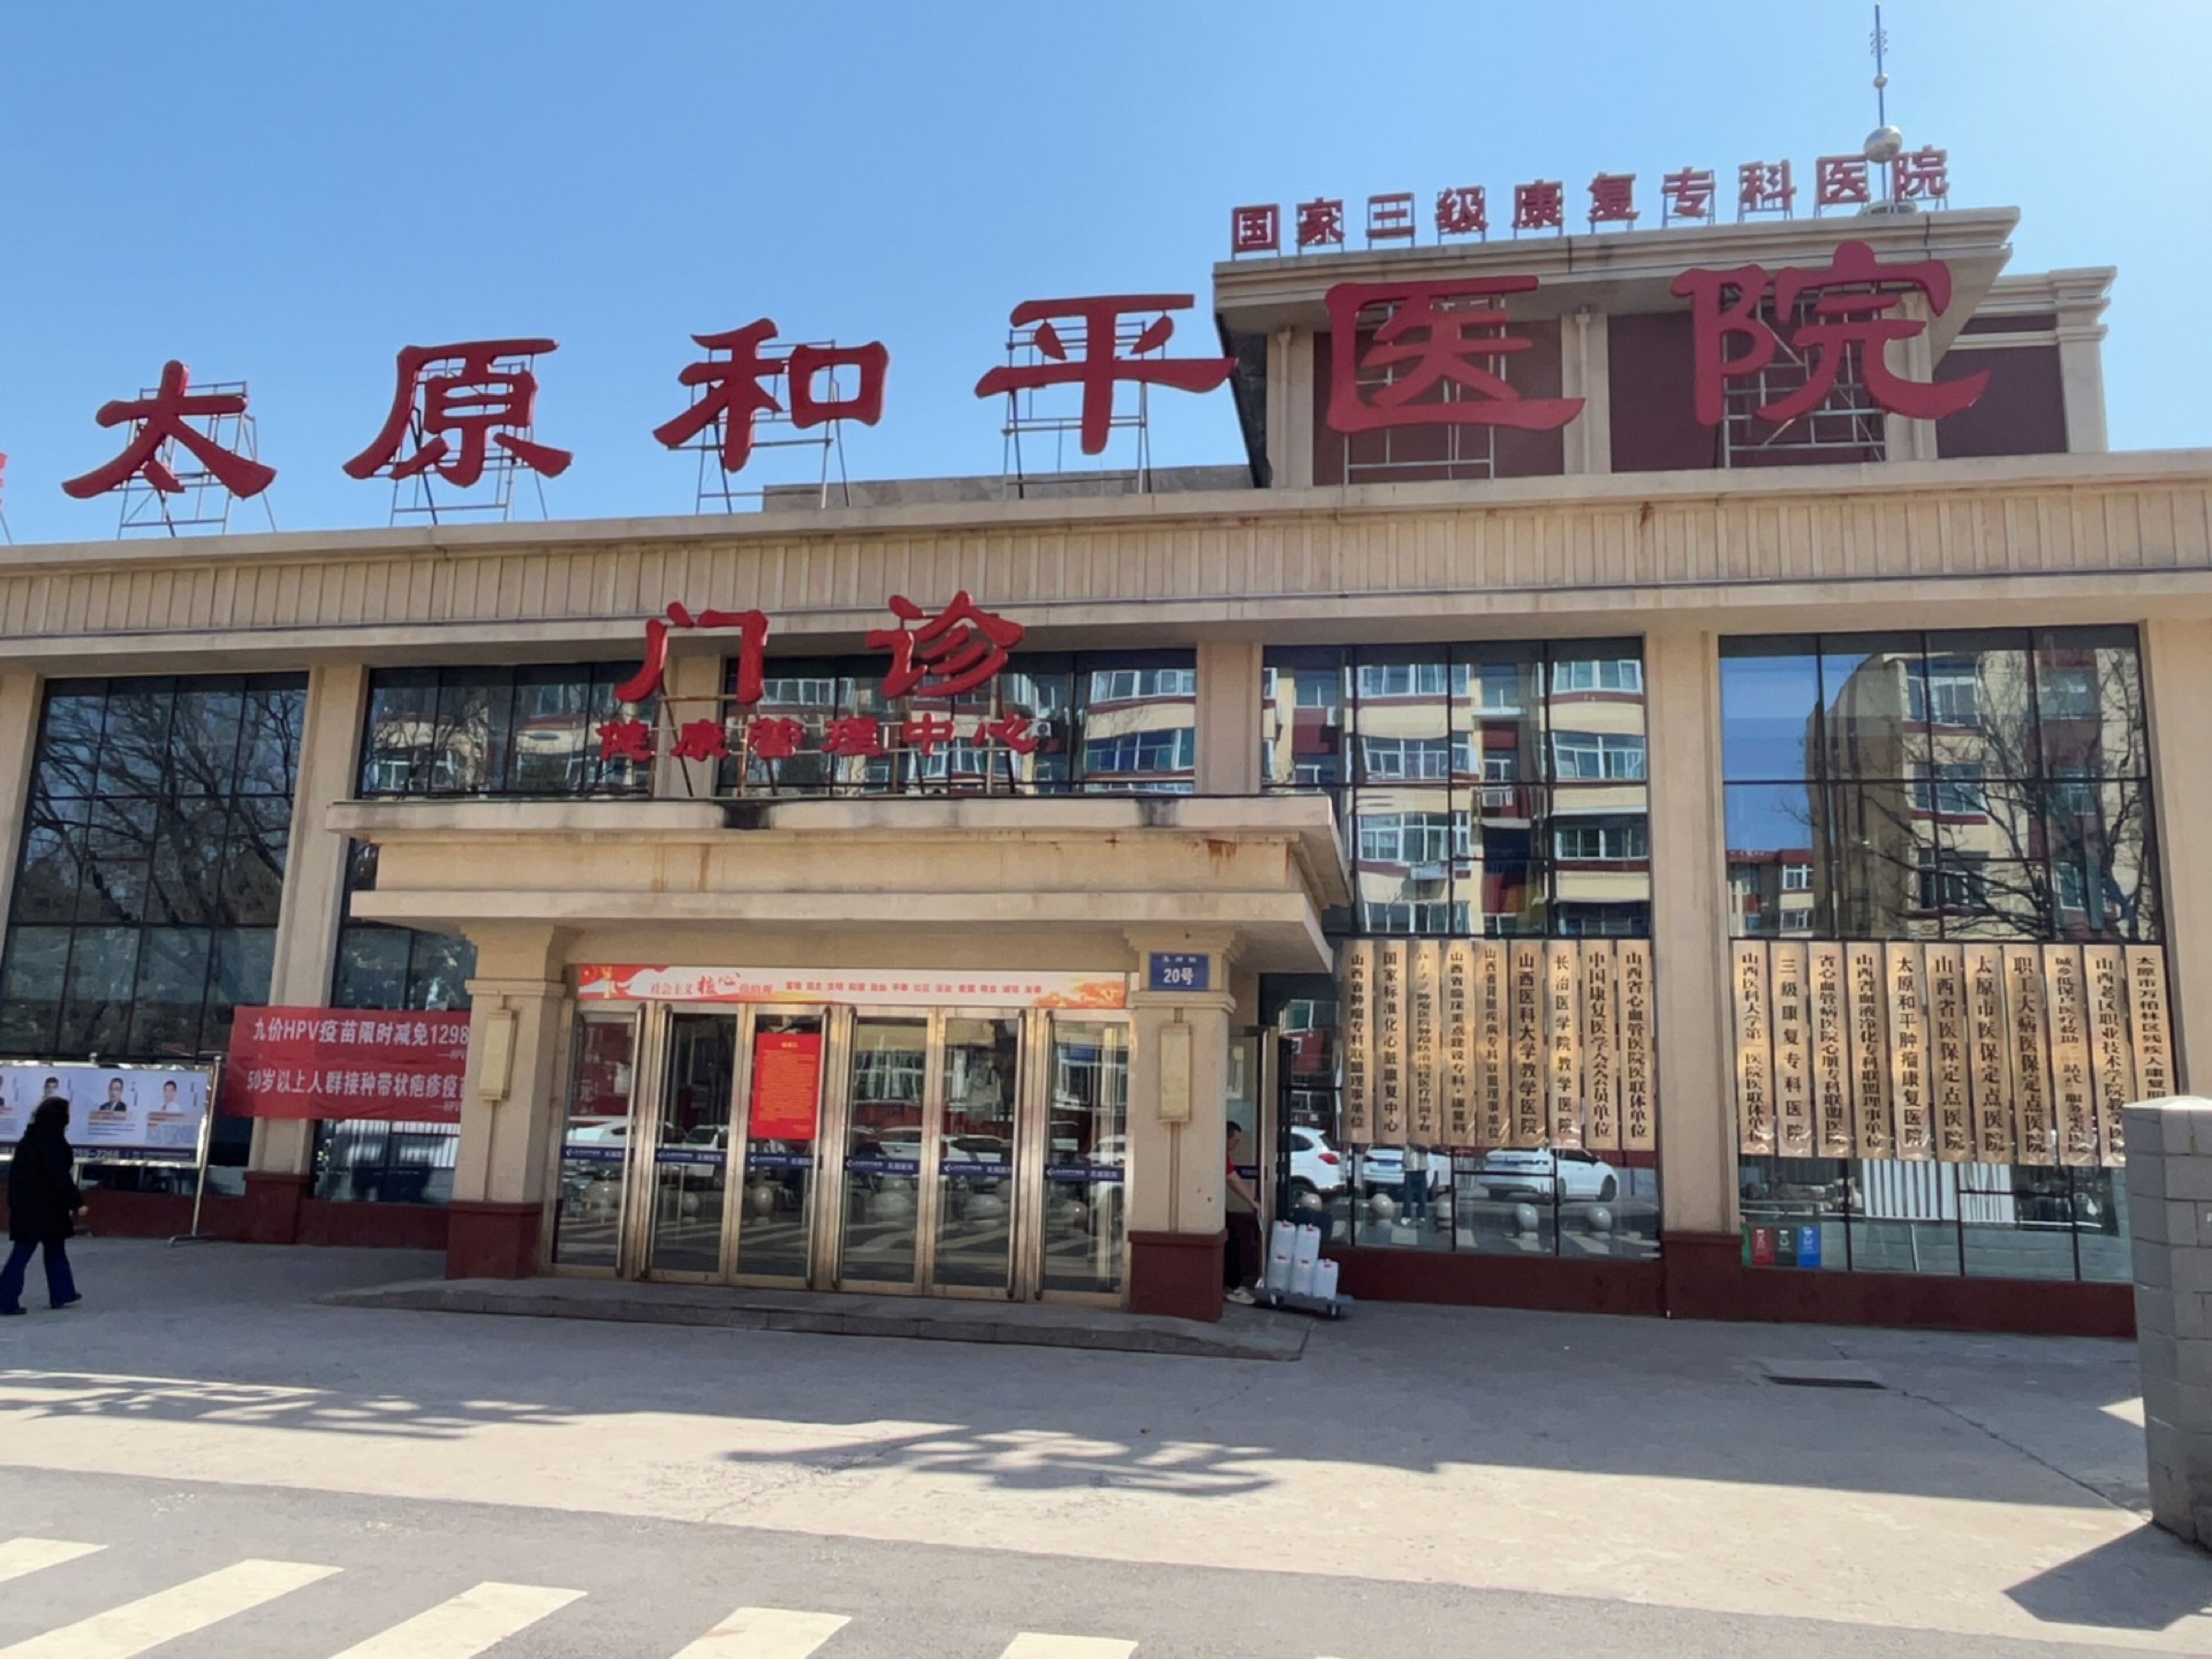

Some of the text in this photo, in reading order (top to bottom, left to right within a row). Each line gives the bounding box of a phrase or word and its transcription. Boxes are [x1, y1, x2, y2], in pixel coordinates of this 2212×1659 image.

[1231, 146, 1950, 253] 国家三级康复专科医院
[62, 243, 1989, 497] 太原和平医院
[596, 712, 1039, 762] 健康管理中心
[614, 589, 1026, 705] 门诊
[252, 1016, 469, 1047] 九价HPV疫苗限时减免1298
[1164, 967, 1194, 986] 20号
[1519, 952, 1537, 1135] 山西医科大学教学医院
[1553, 954, 1572, 1134] 长治医学院教学医院
[1589, 952, 1611, 1138] 中国康复医学会会员单位
[1779, 958, 1804, 1142] 三级康复专科医院
[1896, 956, 1923, 1148] 太原和平肿瘤康复医院
[1935, 955, 1965, 1150] 山西省医保定点医院
[1975, 955, 2005, 1152] 太原市医保定点医院
[2013, 956, 2046, 1153] 职工大病医保定点医院
